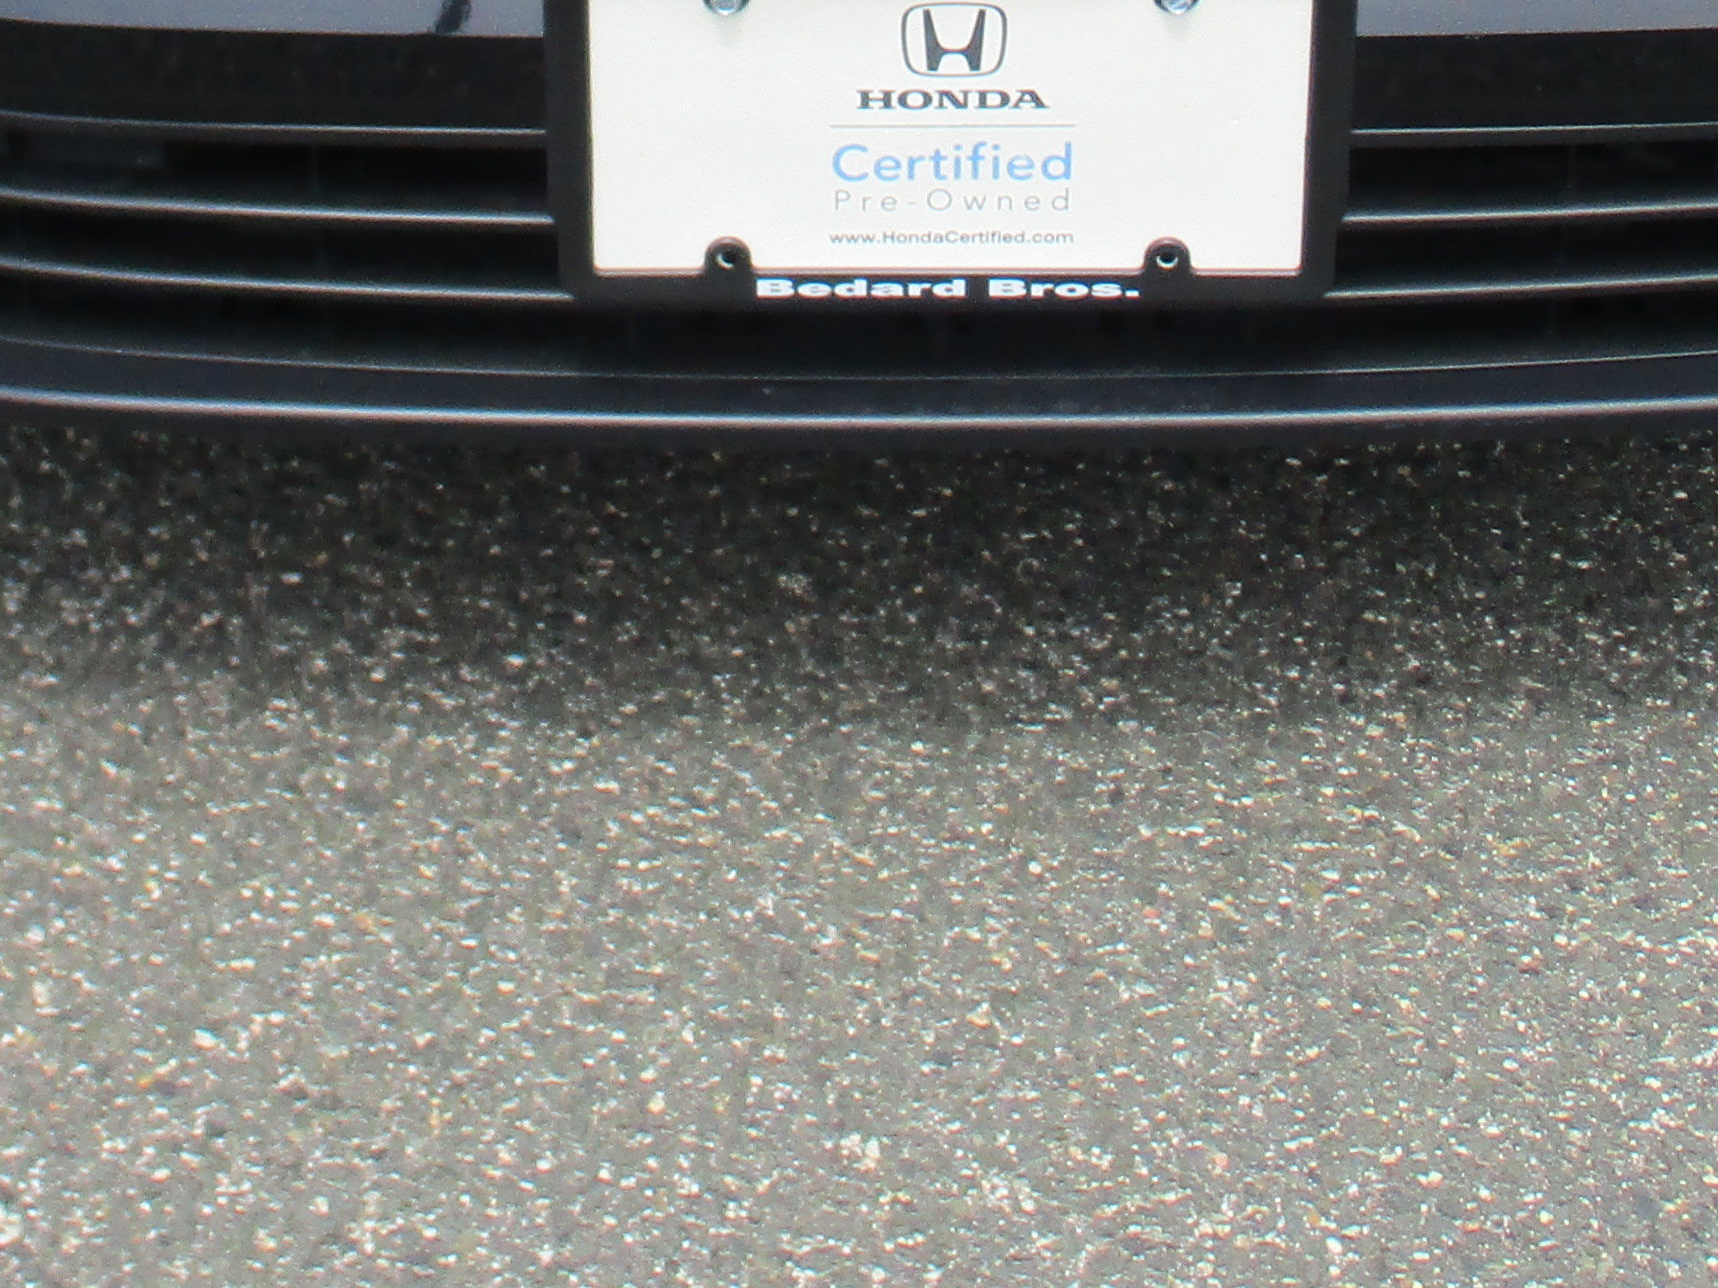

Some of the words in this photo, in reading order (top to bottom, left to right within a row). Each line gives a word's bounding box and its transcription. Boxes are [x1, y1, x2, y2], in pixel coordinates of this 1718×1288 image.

[855, 88, 1051, 111] HONDA
[831, 140, 1074, 183] Certified
[833, 187, 1071, 213] Pre-Owned
[828, 229, 1075, 246] www.HondaCertified.com
[755, 277, 968, 300] Bedard
[987, 278, 1142, 300] Bros.
